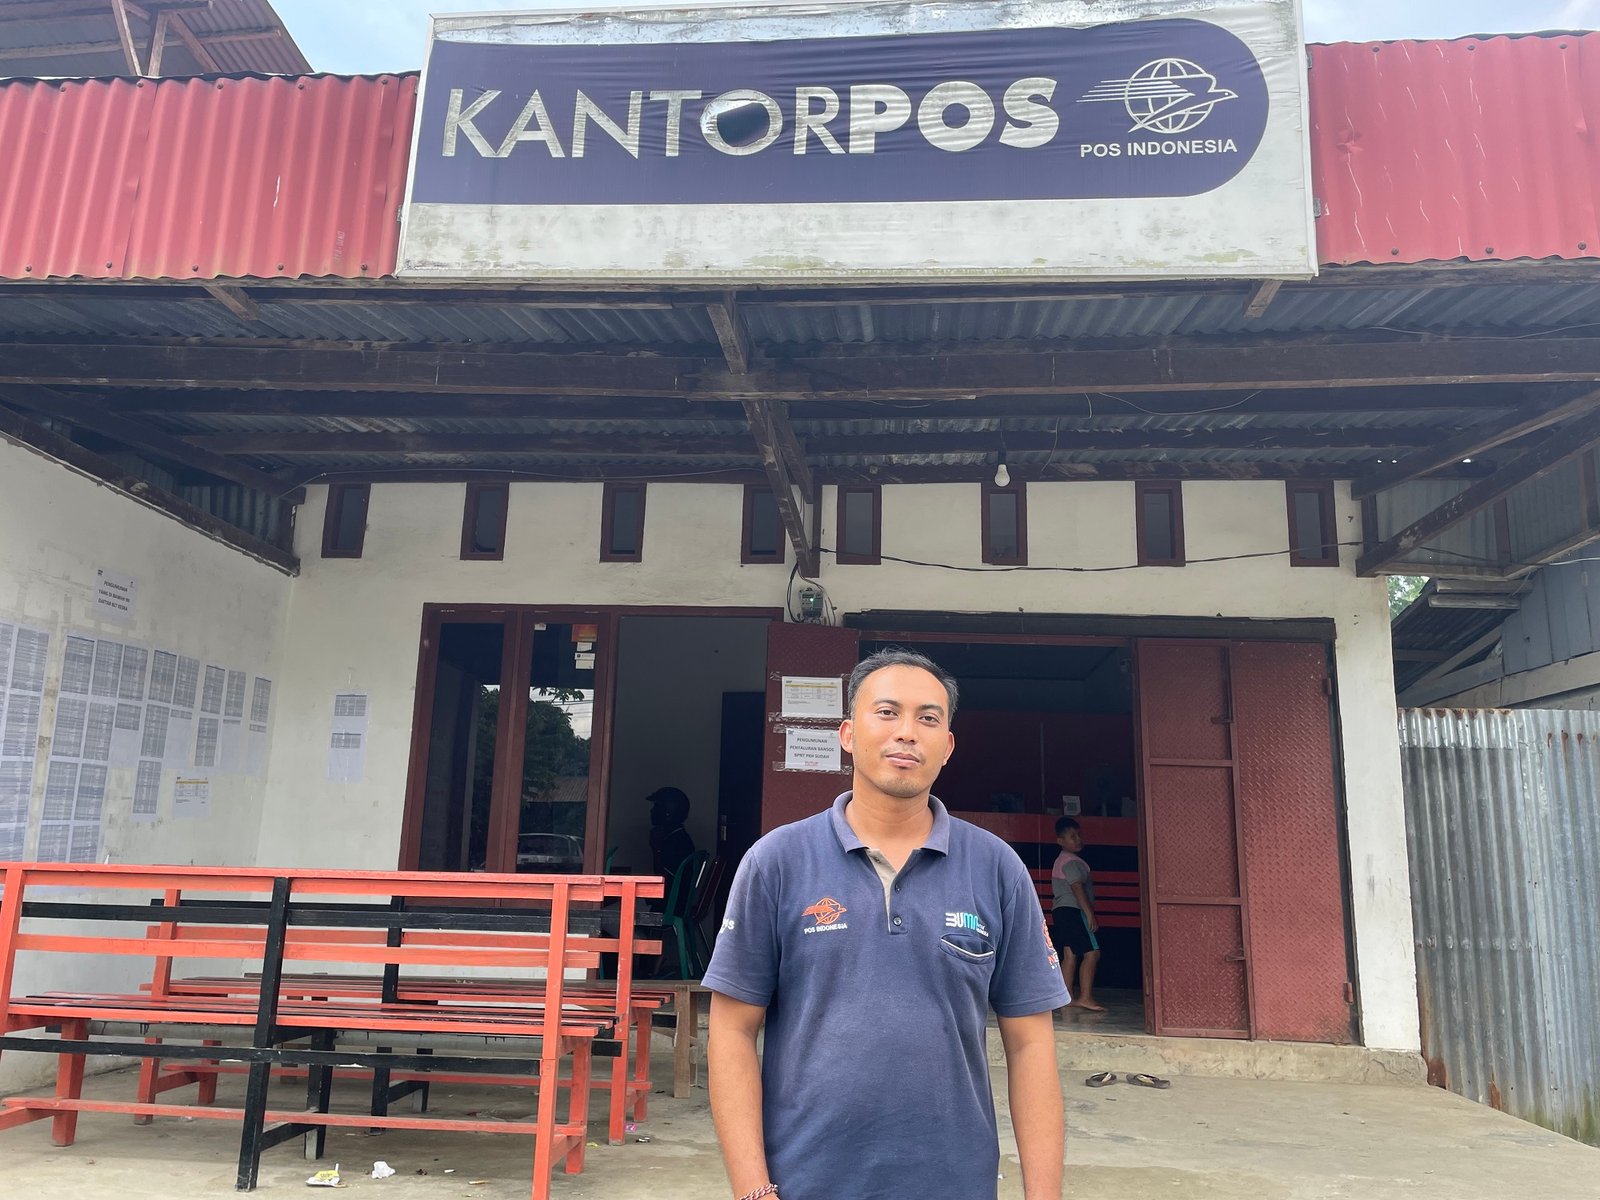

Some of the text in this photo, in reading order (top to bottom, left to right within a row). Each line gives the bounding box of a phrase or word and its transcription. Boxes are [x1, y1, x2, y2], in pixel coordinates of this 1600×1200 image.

[1080, 138, 1238, 158] POS INDONESIA
[804, 923, 848, 935] POS INDONESIA
